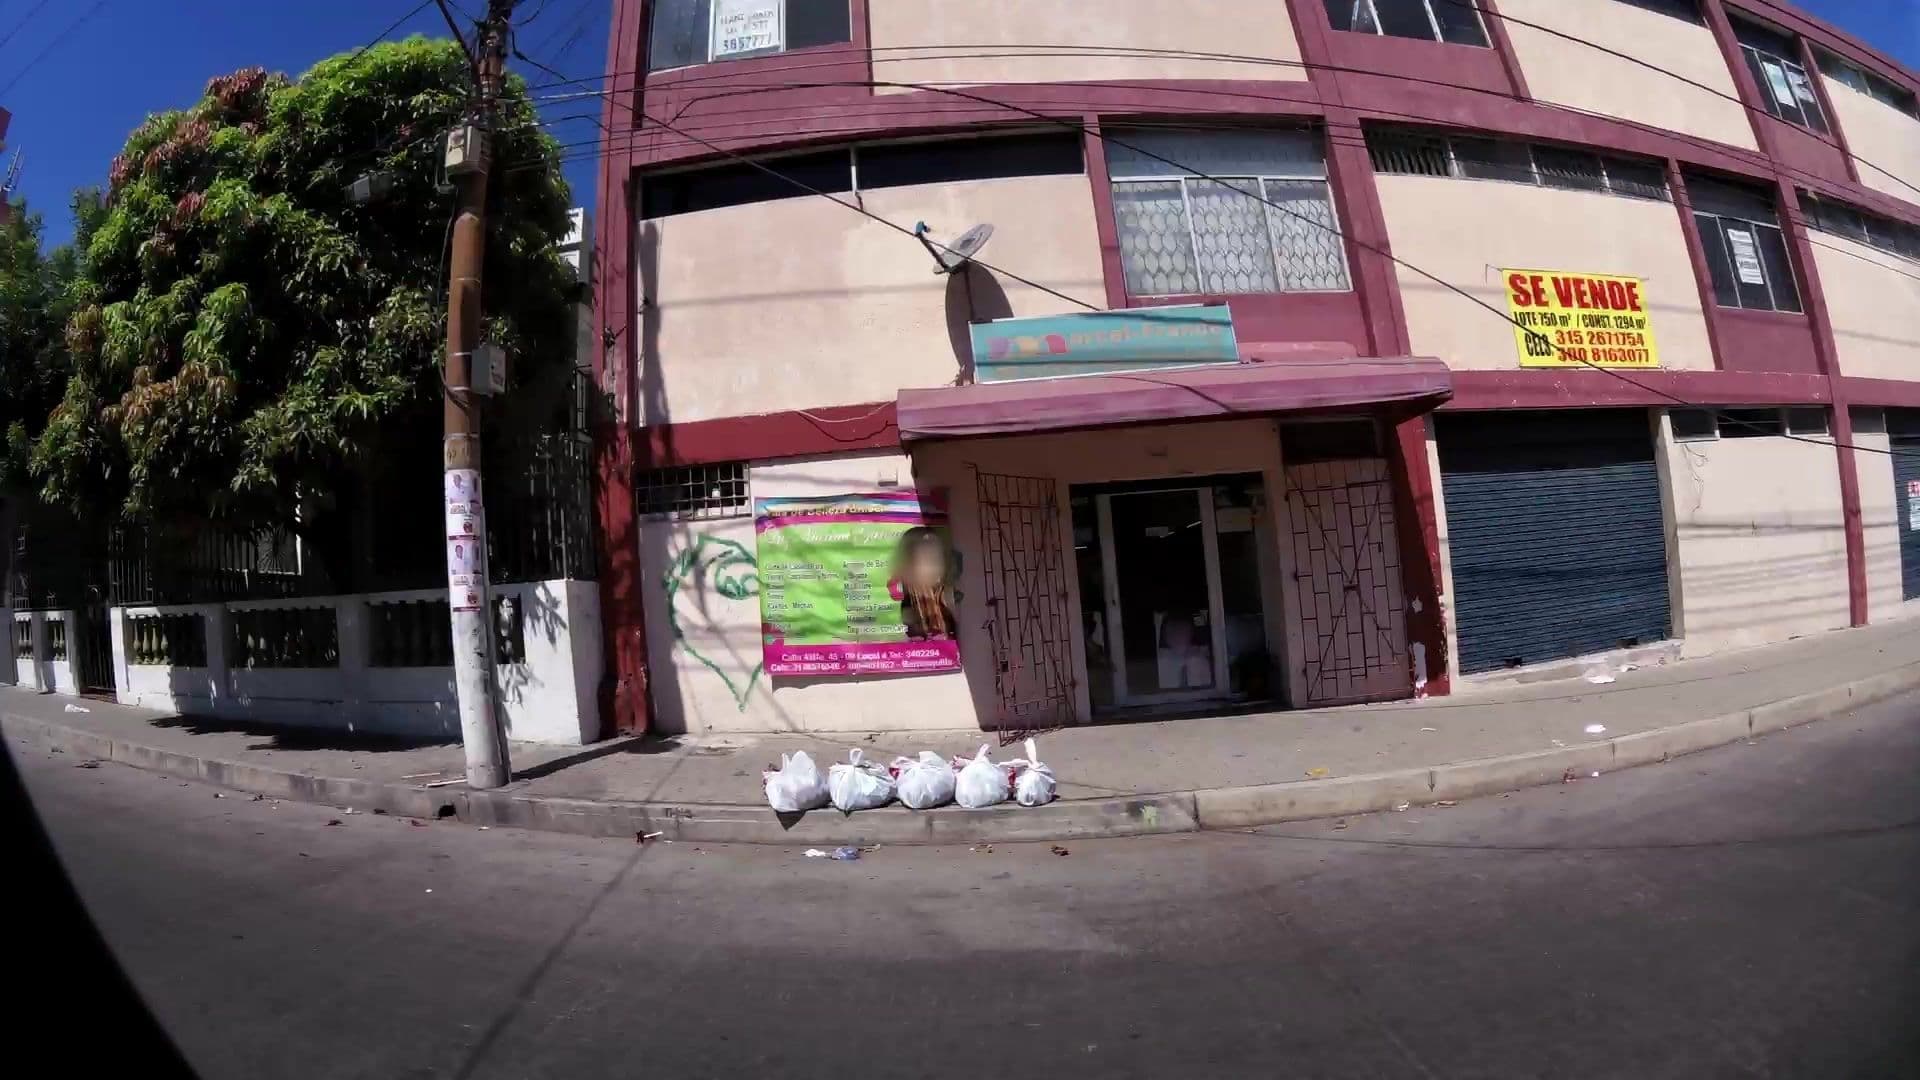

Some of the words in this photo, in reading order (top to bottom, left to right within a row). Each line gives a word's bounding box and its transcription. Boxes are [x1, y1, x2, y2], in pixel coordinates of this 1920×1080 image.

[1508, 273, 1550, 308] SE
[1551, 276, 1642, 312] VENDE
[1513, 311, 1537, 326] LOTE
[1555, 330, 1583, 345] 315
